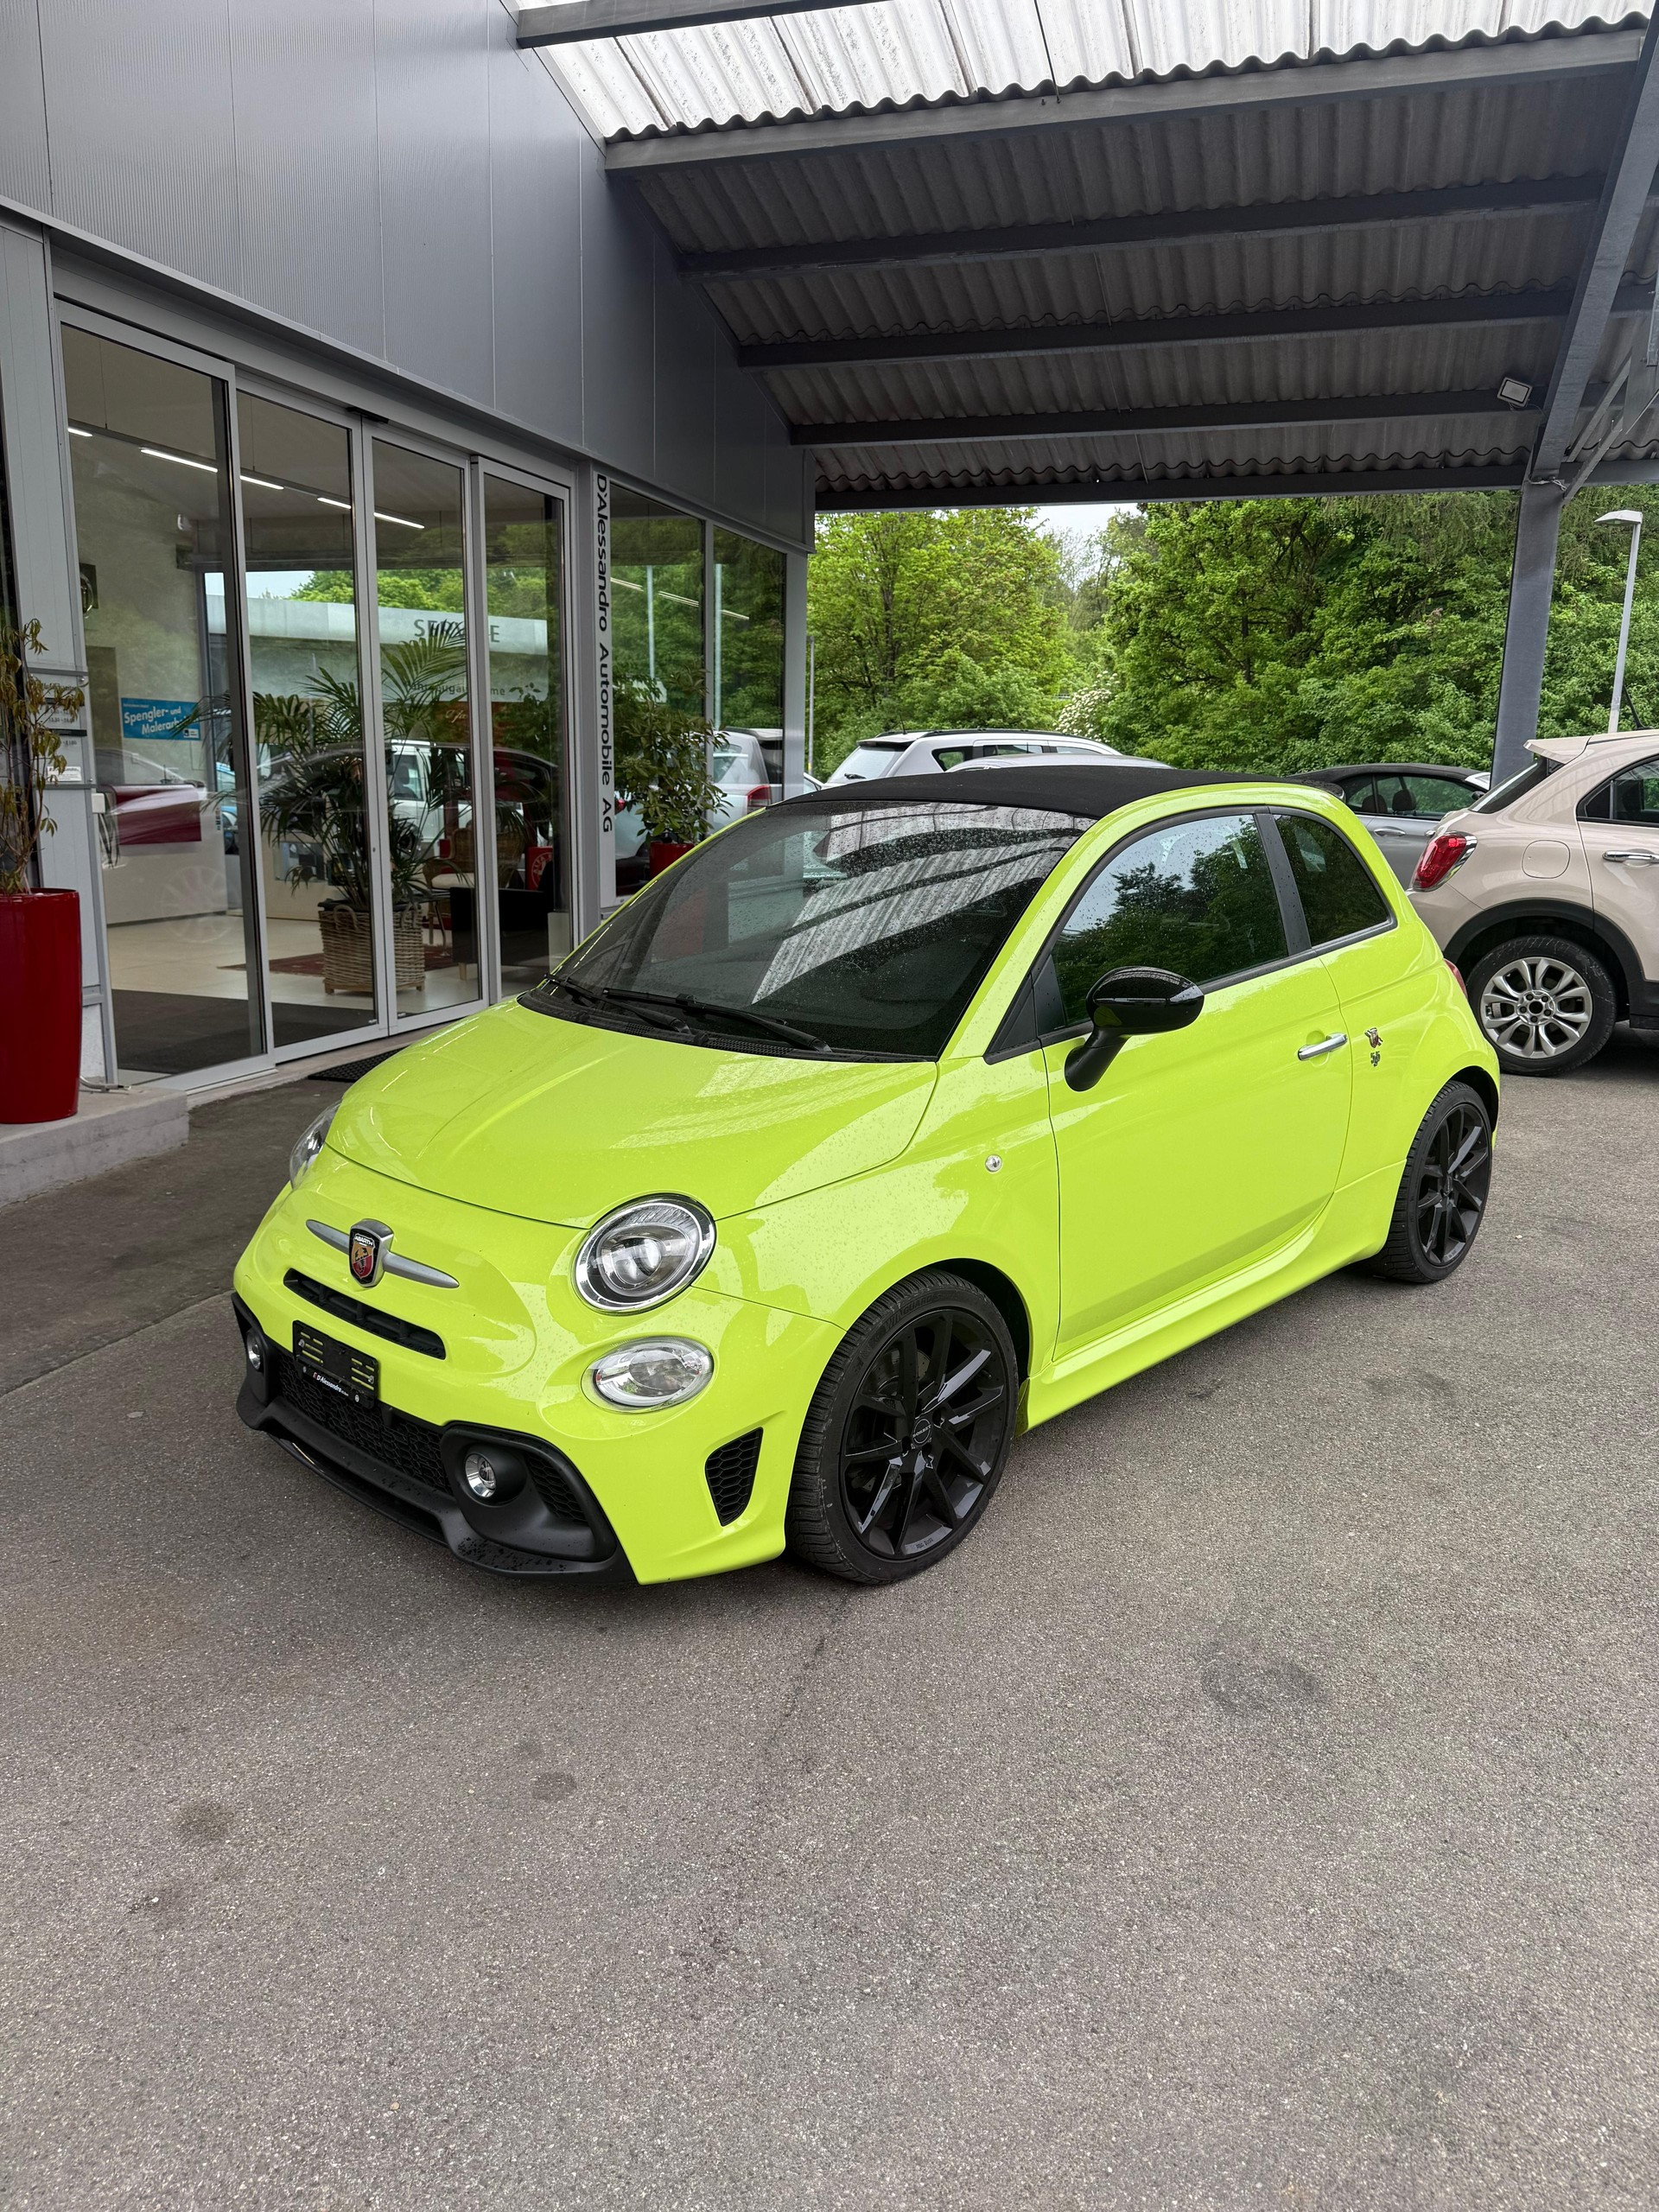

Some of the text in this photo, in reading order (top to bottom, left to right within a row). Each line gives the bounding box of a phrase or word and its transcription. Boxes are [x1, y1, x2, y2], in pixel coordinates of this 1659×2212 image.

[597, 474, 613, 833] D'Alessandro Automobile AG
[124, 706, 181, 726] Spengler- und
[354, 1236, 373, 1246] ABARTH
